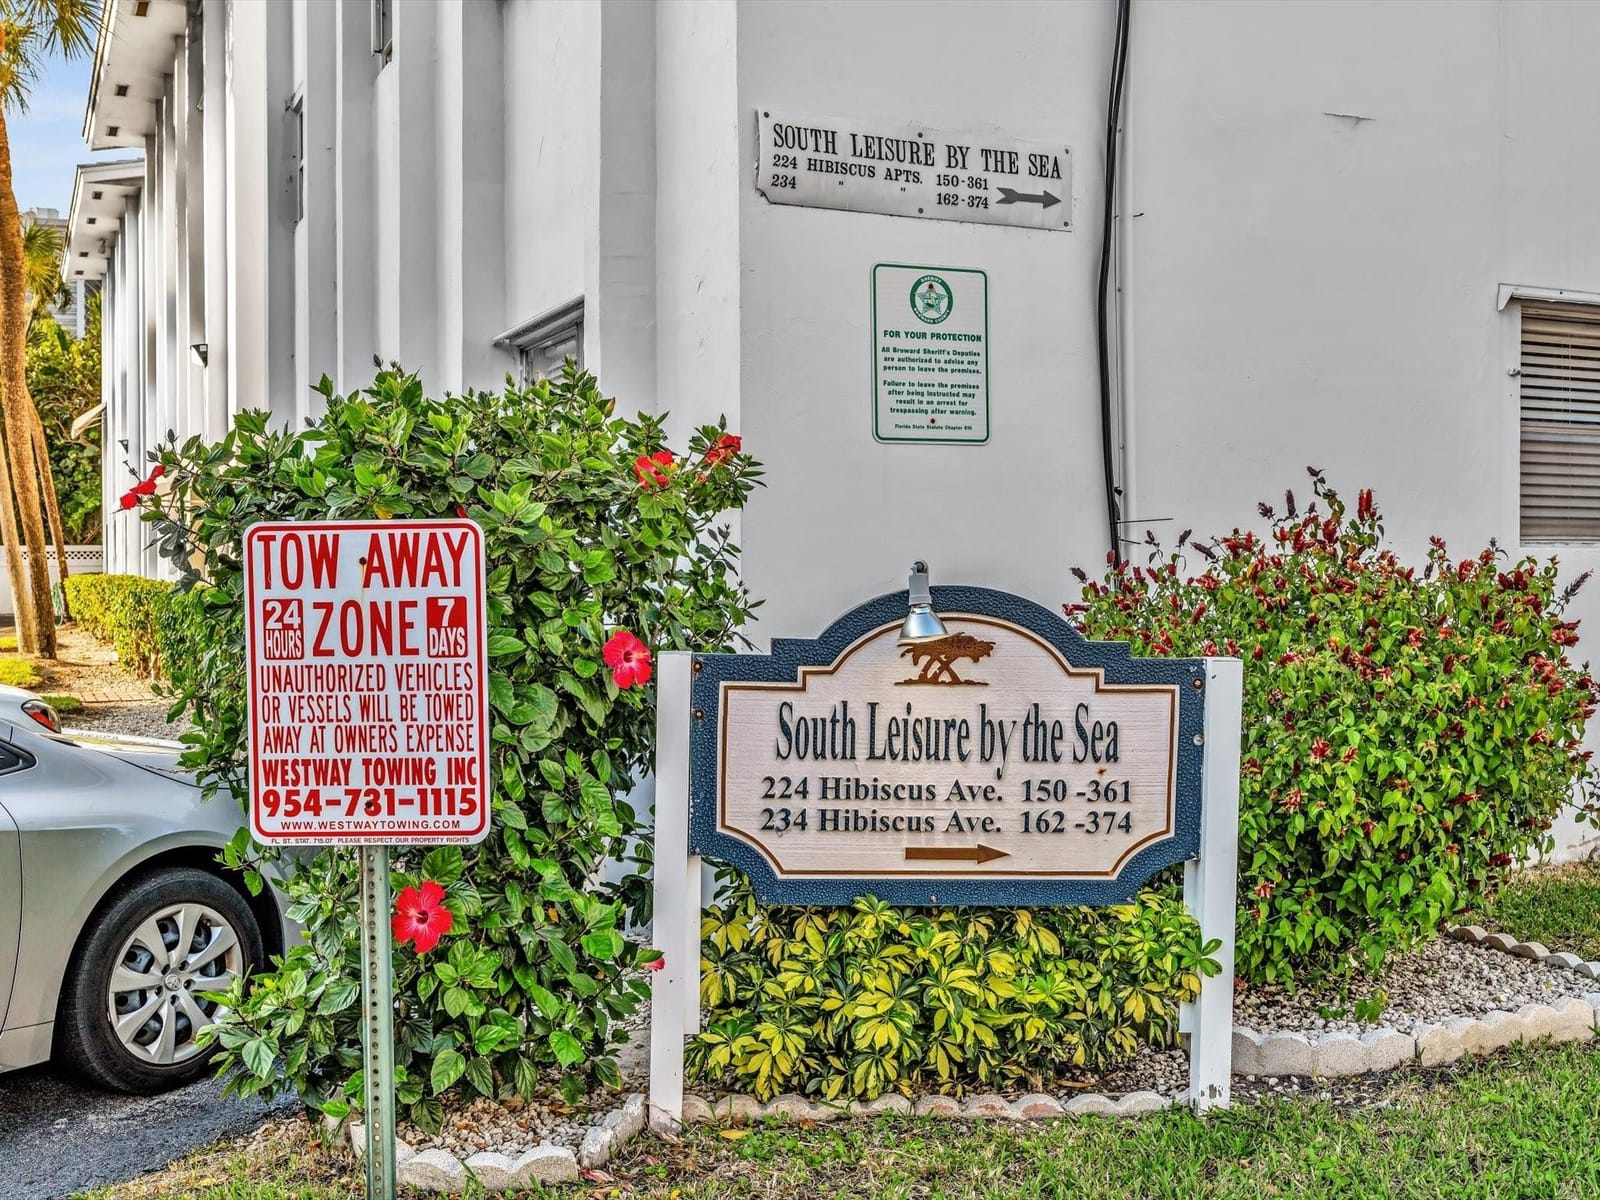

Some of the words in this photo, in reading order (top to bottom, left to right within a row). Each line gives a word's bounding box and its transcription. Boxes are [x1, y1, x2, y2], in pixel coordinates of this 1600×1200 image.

[773, 123, 838, 155] SOUTH
[850, 133, 935, 166] LEISURE
[945, 144, 971, 169] BY
[981, 148, 1019, 175] THE
[1028, 153, 1062, 180] SEA
[773, 154, 798, 169] 224
[807, 158, 876, 178] HIBISCUS
[884, 167, 923, 184] APTS.
[936, 174, 989, 190] 150-361
[771, 173, 797, 189] 234
[936, 192, 989, 209] 162-374
[883, 330, 901, 338] FOR
[904, 331, 927, 340] YOUR
[930, 332, 982, 342] PROTECTION
[897, 356, 932, 364] authorized
[923, 348, 950, 356] Sheriff's
[952, 349, 981, 357] Deputies
[890, 407, 929, 415] trespassing
[257, 533, 340, 590] TOW
[362, 531, 469, 588] AWAY
[265, 600, 302, 630] 24
[437, 598, 455, 627] 7
[312, 599, 420, 657] ZONE
[429, 627, 466, 656] DAYS
[265, 629, 302, 659] HOURS
[260, 663, 386, 693] UNAUTHORIZED
[394, 662, 473, 692] VEHICLES
[262, 695, 281, 724] OR
[288, 694, 352, 723] VESSELS
[359, 694, 393, 723] WILL
[400, 693, 418, 722] BE
[425, 692, 474, 722] TOWED
[263, 726, 302, 753] AWAY
[310, 725, 326, 753] AT
[335, 725, 398, 753] OWNERS
[407, 723, 475, 753] EXPENSE
[775, 700, 857, 761] South
[866, 701, 971, 762] Leisure
[979, 703, 1017, 780] by
[1022, 702, 1064, 763] the
[1072, 702, 1119, 764] Sea
[262, 758, 352, 787] WESTWAY
[361, 757, 437, 786] TOWING
[447, 756, 477, 786] INC
[262, 788, 477, 817] 954-731-1115
[760, 776, 809, 800] 224
[818, 776, 937, 801] Hibiscus
[946, 779, 1003, 802] Ave.
[281, 820, 460, 830] WWW.WESTWAYTOWING.COM
[760, 807, 808, 832] 234
[817, 808, 935, 833] Hibiscus
[942, 810, 1002, 834] Ave.
